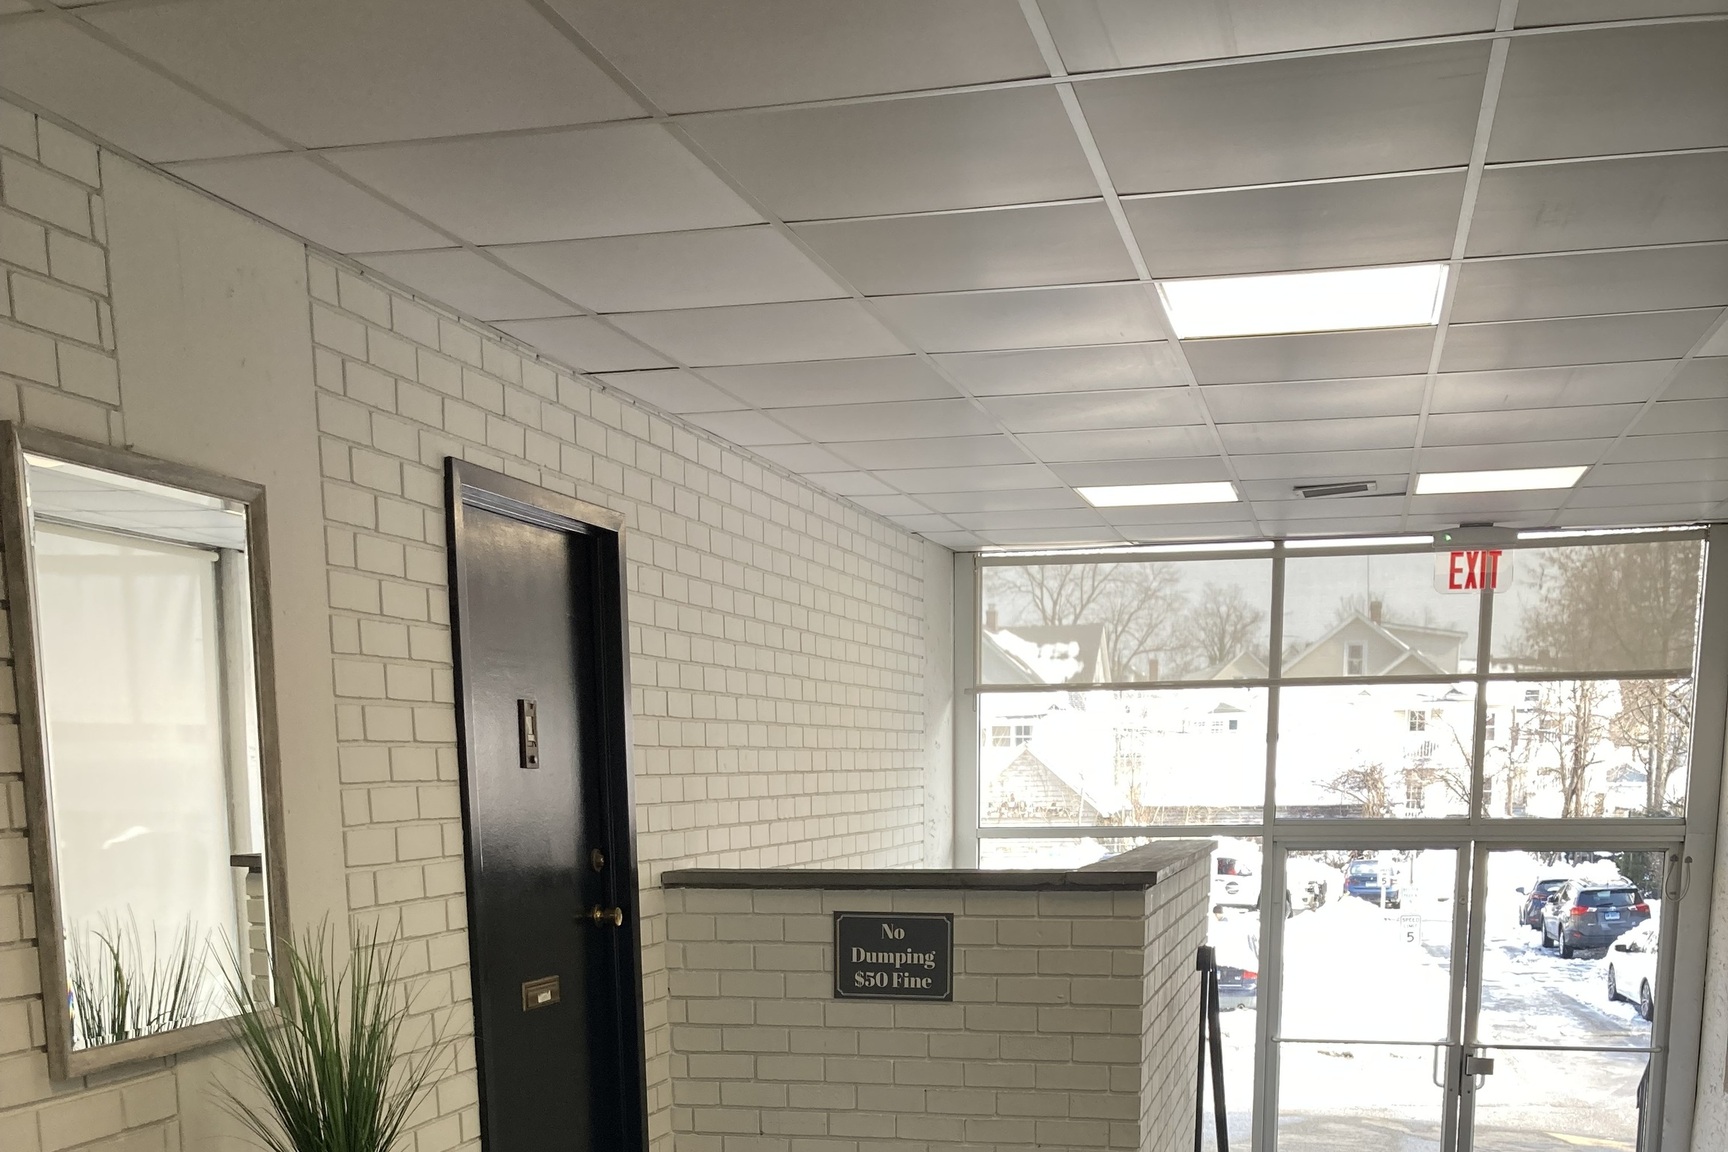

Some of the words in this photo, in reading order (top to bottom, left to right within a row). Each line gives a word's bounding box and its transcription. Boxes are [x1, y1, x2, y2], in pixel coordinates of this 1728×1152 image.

[1448, 550, 1503, 590] EXIT
[881, 923, 905, 940] No
[1406, 931, 1415, 943] 5
[851, 946, 936, 969] Dumping
[854, 970, 889, 988] $50
[892, 972, 932, 989] Fine
